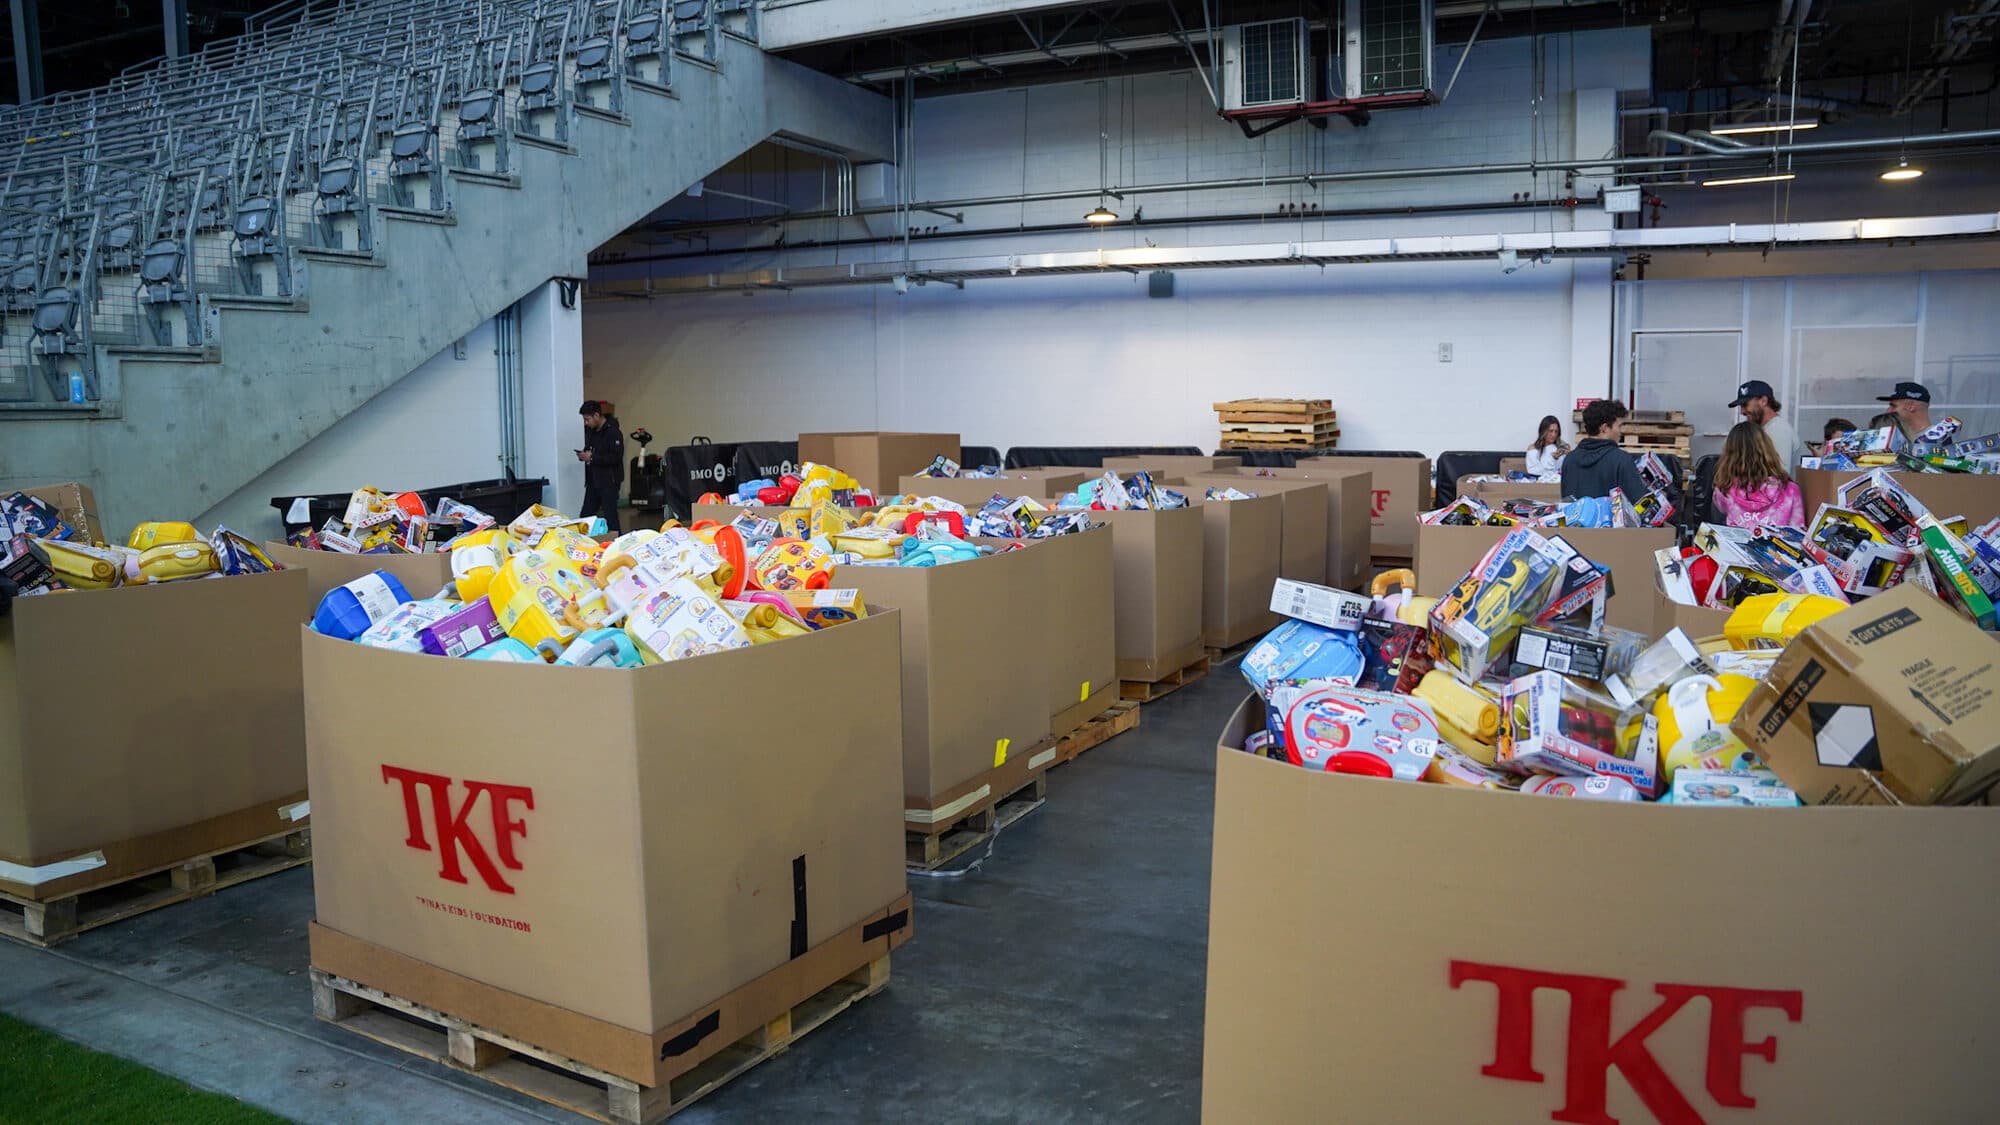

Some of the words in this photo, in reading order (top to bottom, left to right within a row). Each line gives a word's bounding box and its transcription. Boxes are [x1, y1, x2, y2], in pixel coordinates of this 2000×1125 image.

[690, 468, 713, 480] BMO
[760, 464, 780, 476] BMO
[1493, 532, 1518, 564] MUSTANG
[1484, 565, 1495, 578] GT
[1935, 547, 1979, 596] SUBWAY
[1341, 601, 1363, 611] STAR
[1340, 609, 1361, 619] WARS
[1857, 626, 1881, 641] GIFT
[1878, 616, 1905, 633] SETS
[1764, 705, 1787, 733] GIFT
[1784, 680, 1809, 709] SETS
[1414, 745, 1430, 756] 19
[1597, 760, 1608, 771] GT
[1608, 763, 1646, 777] MUSTANG
[1632, 776, 1653, 787] FORD
[381, 763, 535, 895] TKF
[448, 904, 468, 918] KIDS
[470, 910, 532, 933] FOUNDATION
[1450, 960, 1803, 1125] TKF
